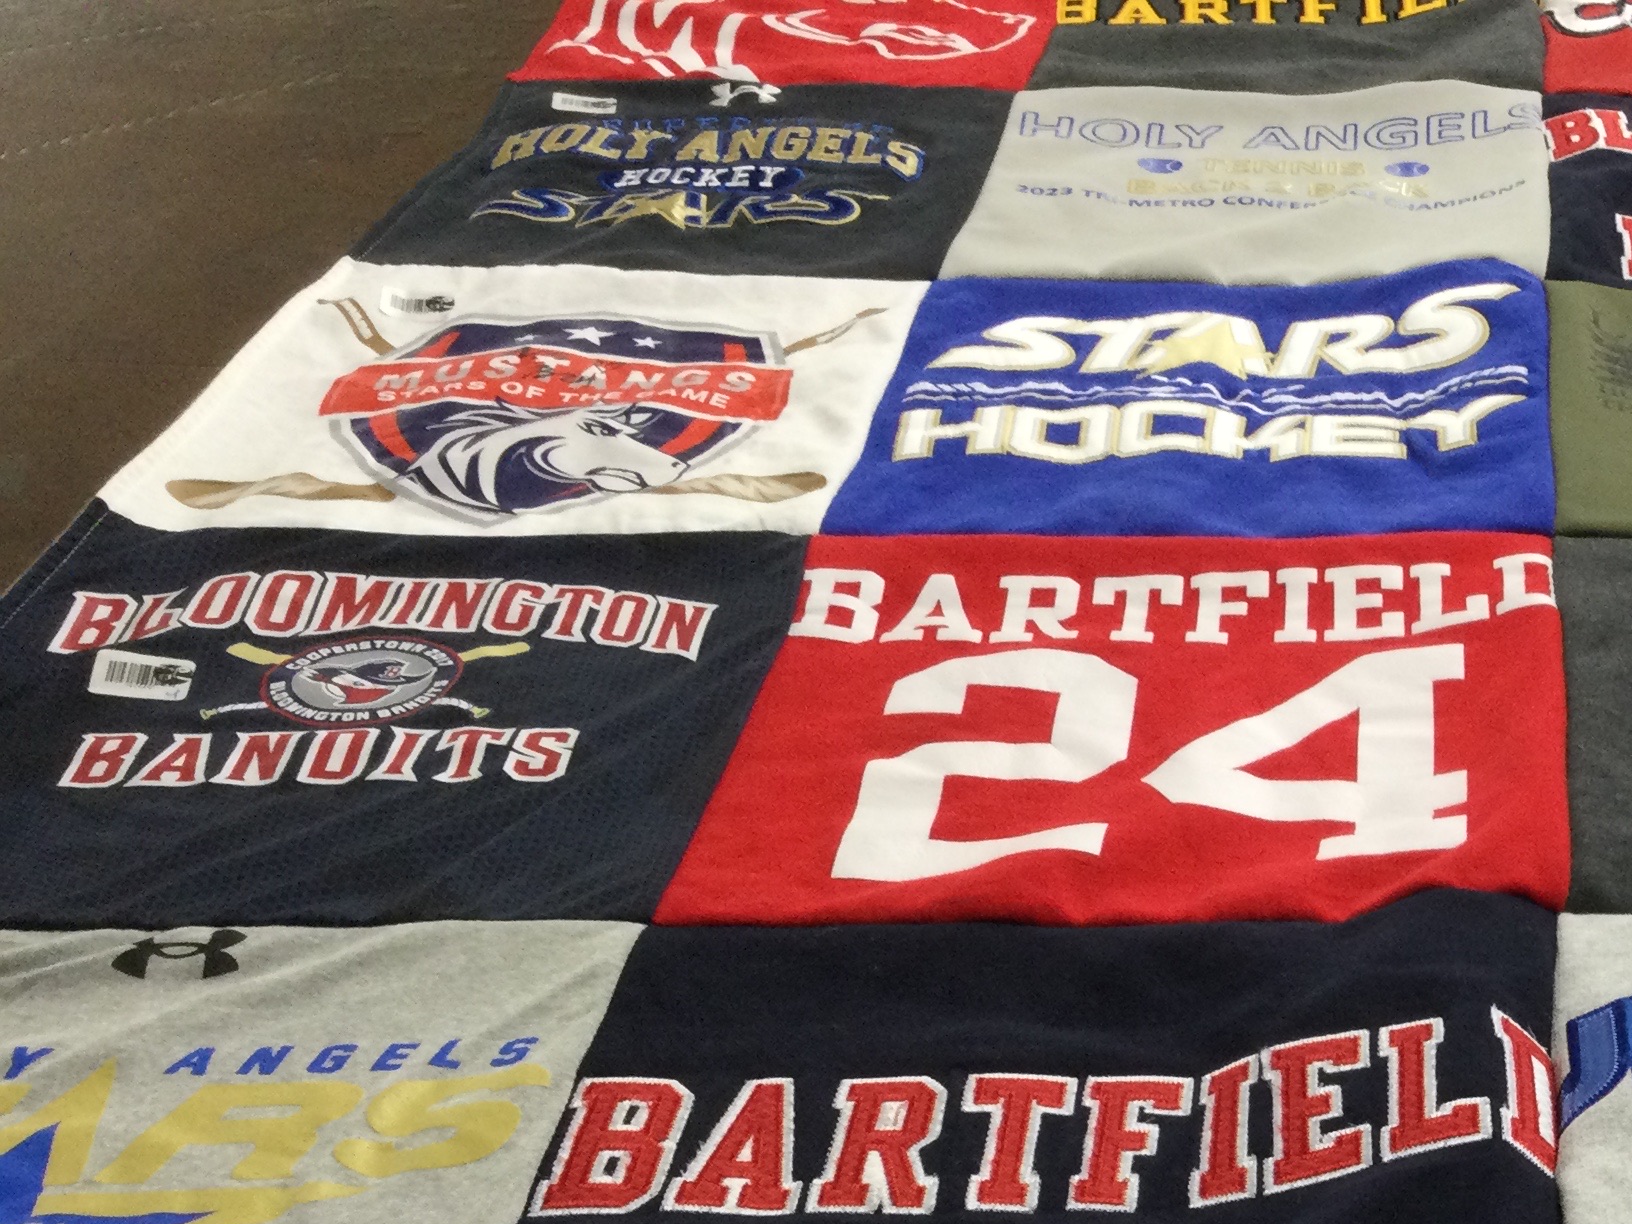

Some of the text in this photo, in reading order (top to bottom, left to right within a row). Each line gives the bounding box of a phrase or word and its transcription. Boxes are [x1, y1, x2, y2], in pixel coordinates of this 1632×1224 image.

[489, 123, 674, 171] HOLY
[674, 126, 930, 184] ANGELS
[1019, 103, 1541, 152] HOLY ANGELS
[613, 166, 786, 189] HOCKEY
[1015, 183, 1074, 197] 2023
[1202, 156, 1368, 177] TENNIS
[924, 283, 1523, 379] STARS
[374, 353, 758, 394] MUSTANGS
[376, 380, 486, 402] STARS
[501, 381, 546, 400] OF
[891, 392, 1527, 466] HOCKEY
[47, 569, 719, 662] BLOOMINGTON
[788, 552, 1558, 644] BARTFIELD
[286, 639, 427, 670] COOPERSTOWN
[269, 680, 371, 722] BLOOMINGTON
[56, 727, 580, 787] BANDITS
[830, 643, 1469, 882] 24
[163, 1036, 540, 1077] ANGELS
[0, 1057, 551, 1179] ARS
[529, 1005, 1556, 1217] BARTFIELD
